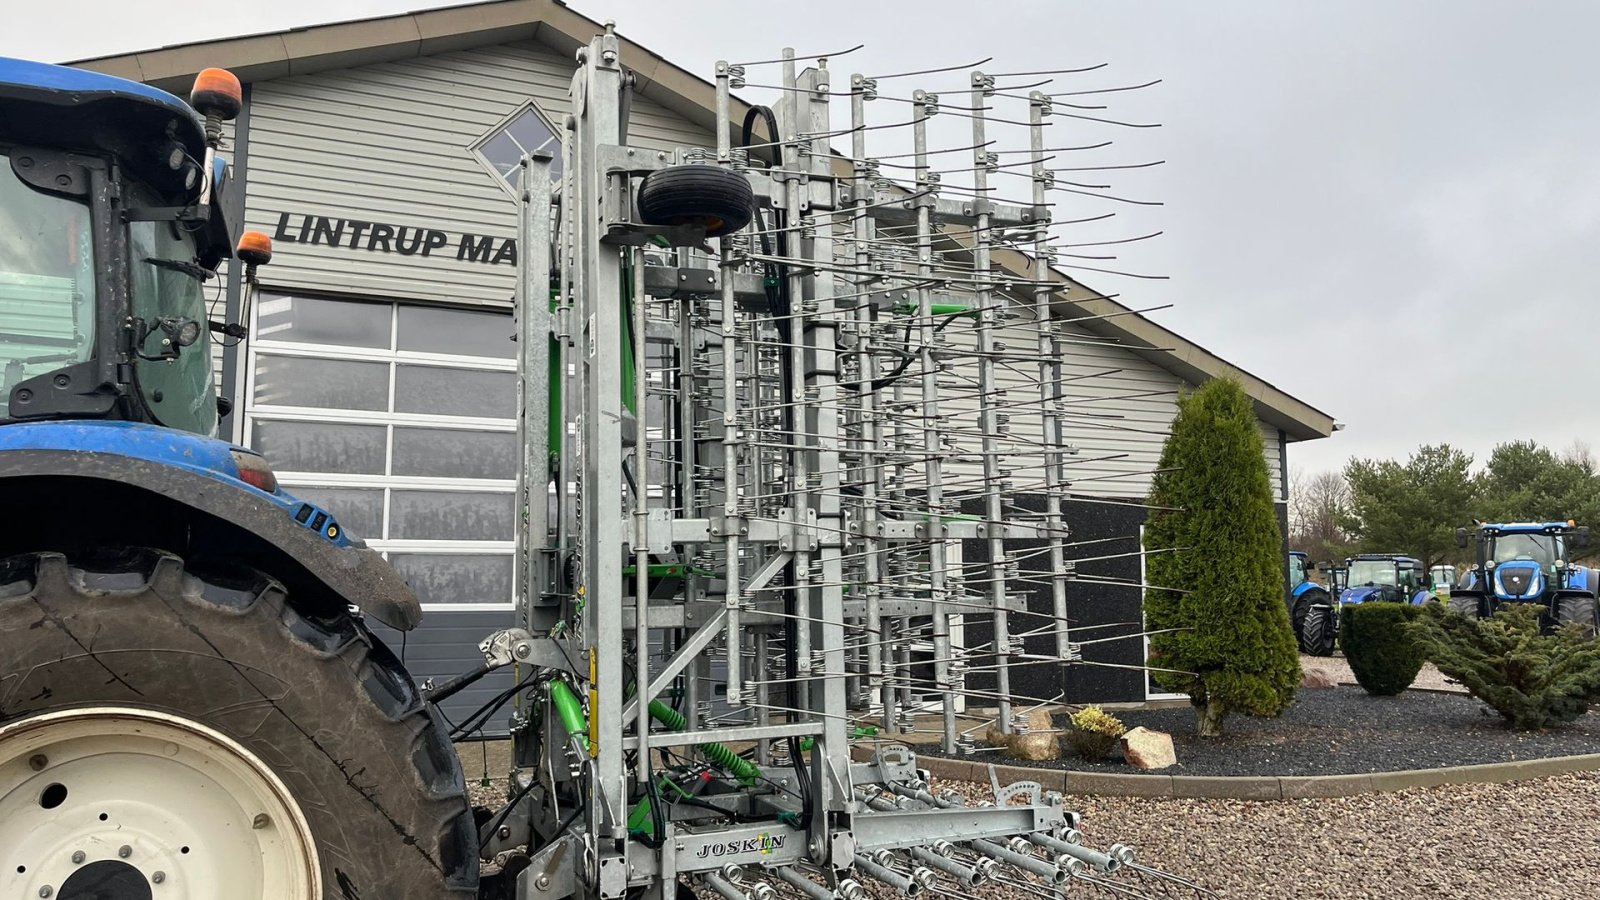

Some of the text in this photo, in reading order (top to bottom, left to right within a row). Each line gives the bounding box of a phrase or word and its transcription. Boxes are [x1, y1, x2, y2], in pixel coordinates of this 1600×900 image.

[274, 212, 518, 267] LINTRUP MA
[696, 834, 786, 859] JOSKIN
